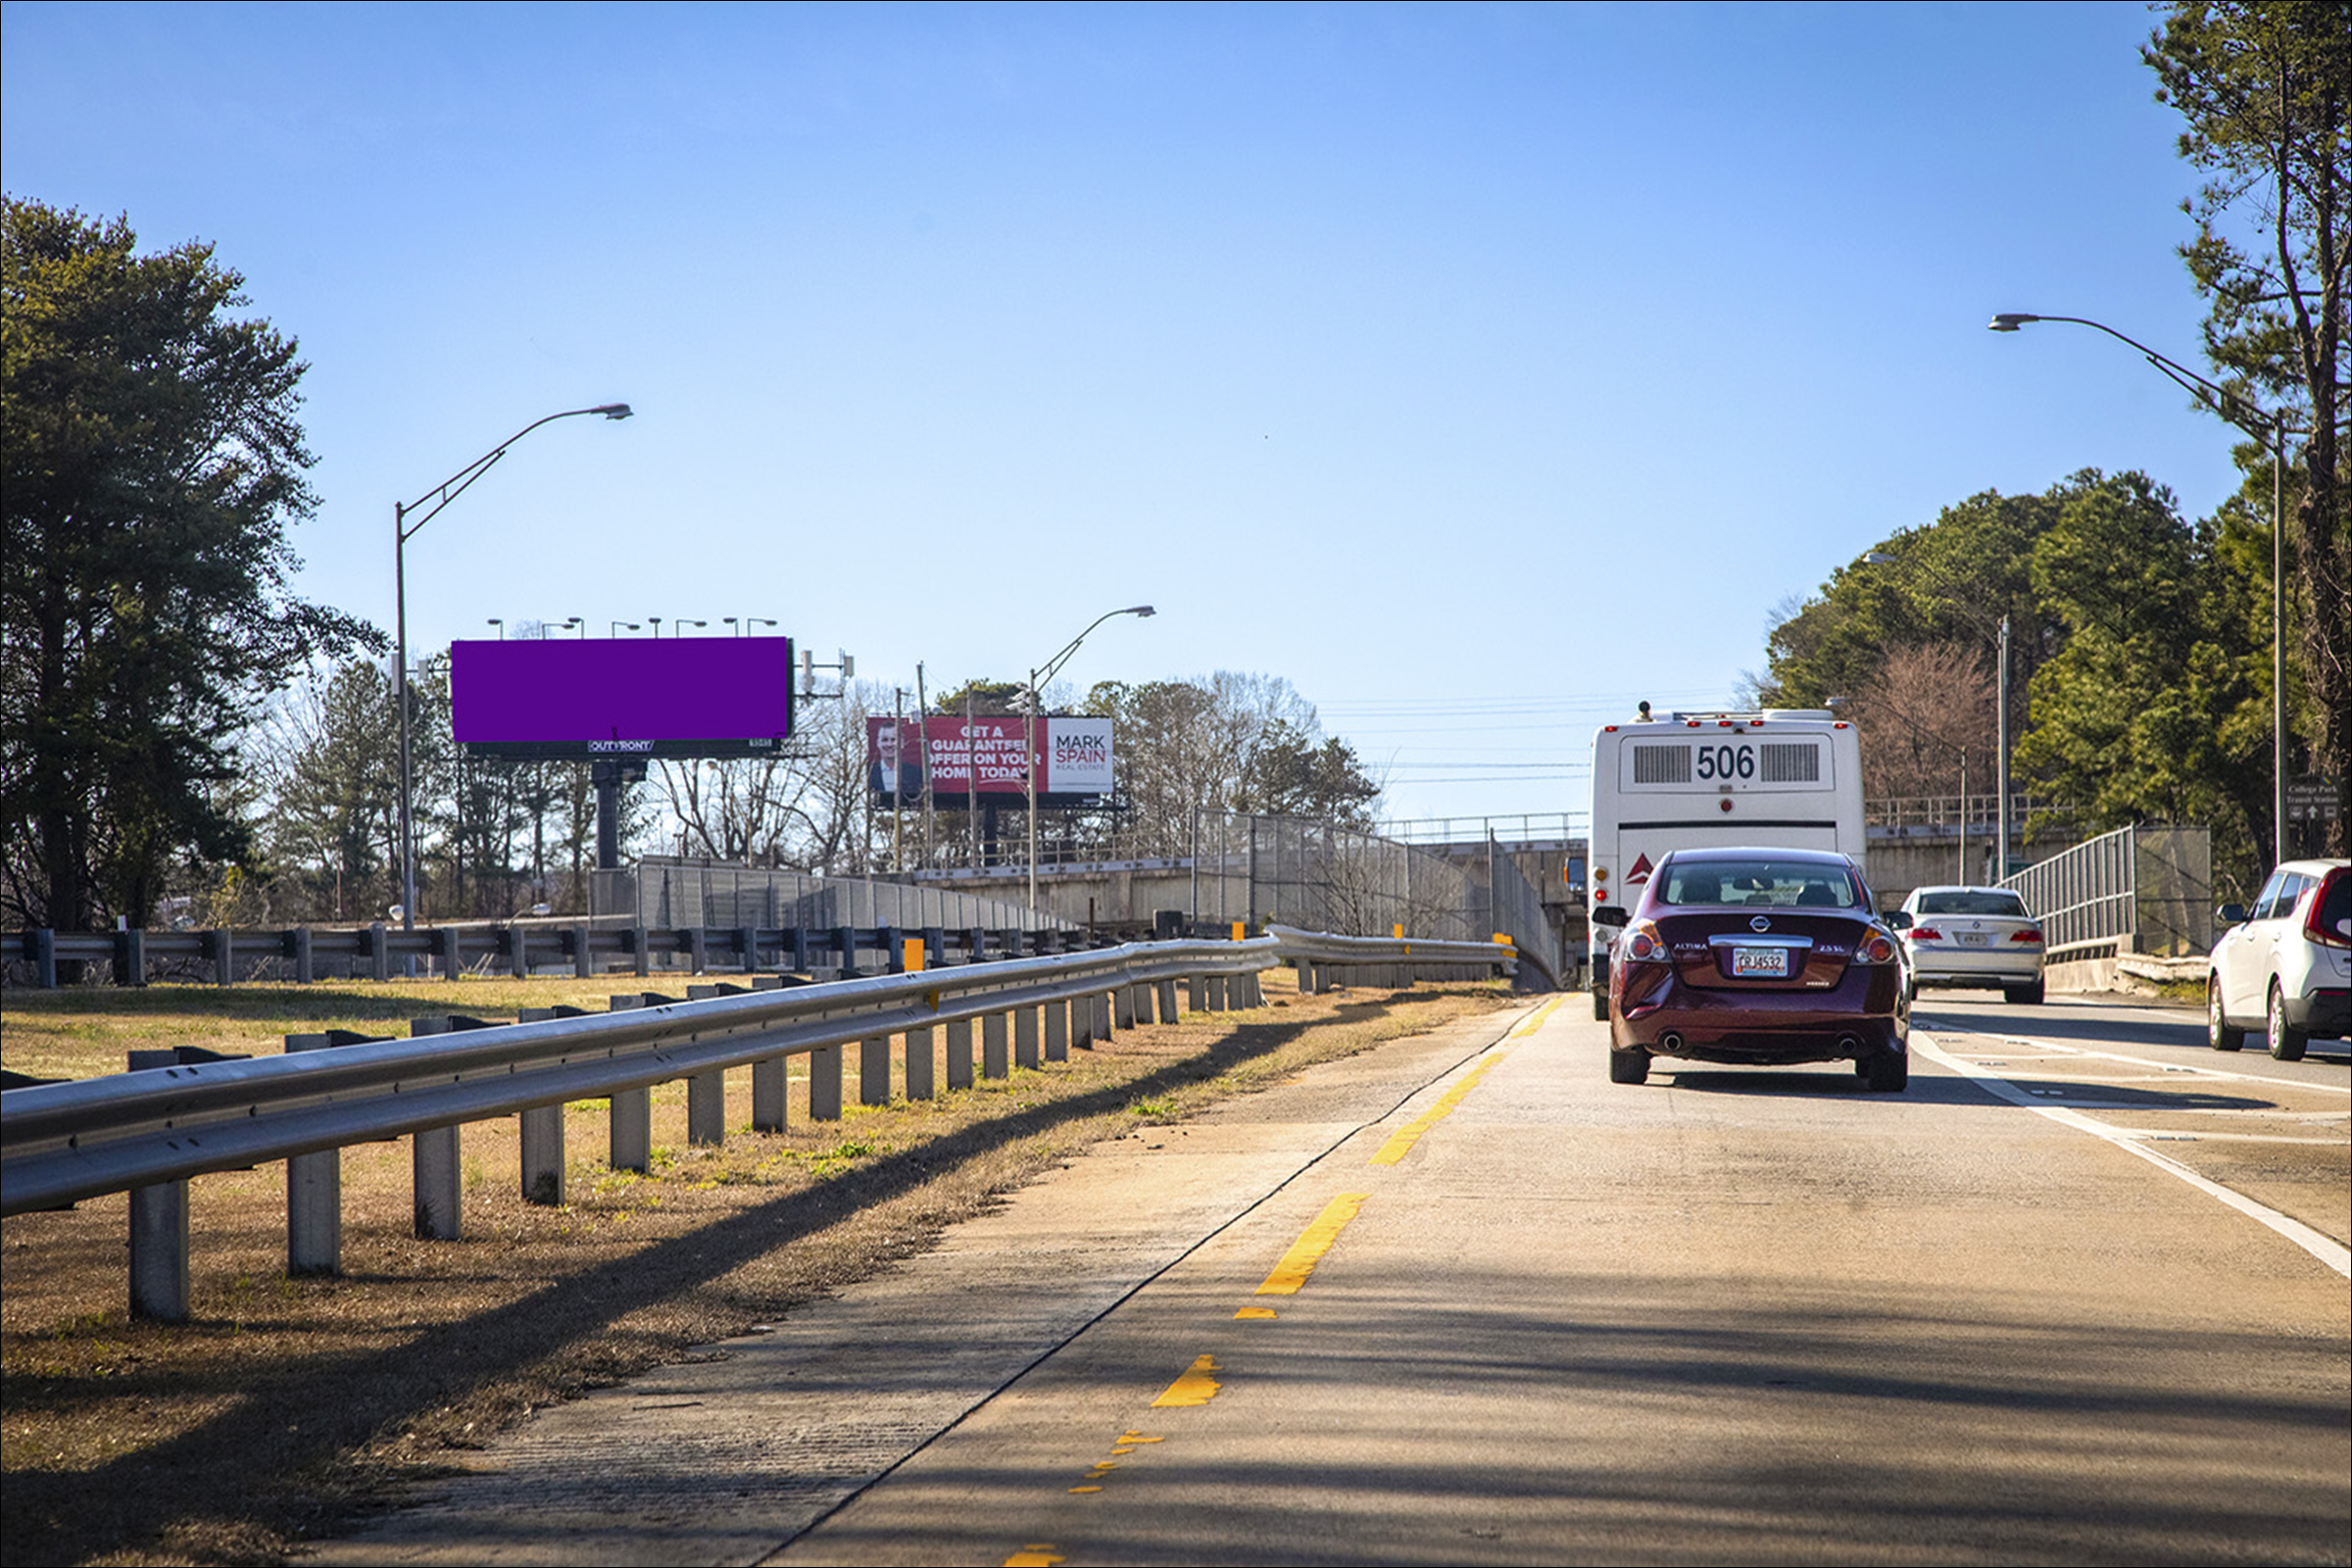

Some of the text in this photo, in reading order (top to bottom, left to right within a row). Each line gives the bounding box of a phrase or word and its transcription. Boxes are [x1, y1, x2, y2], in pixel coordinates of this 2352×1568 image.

[960, 726, 1004, 737] GET A
[1056, 735, 1104, 749] MARK
[974, 754, 996, 764] ON
[1056, 749, 1105, 762] SPAIN
[1697, 745, 1755, 779] 506
